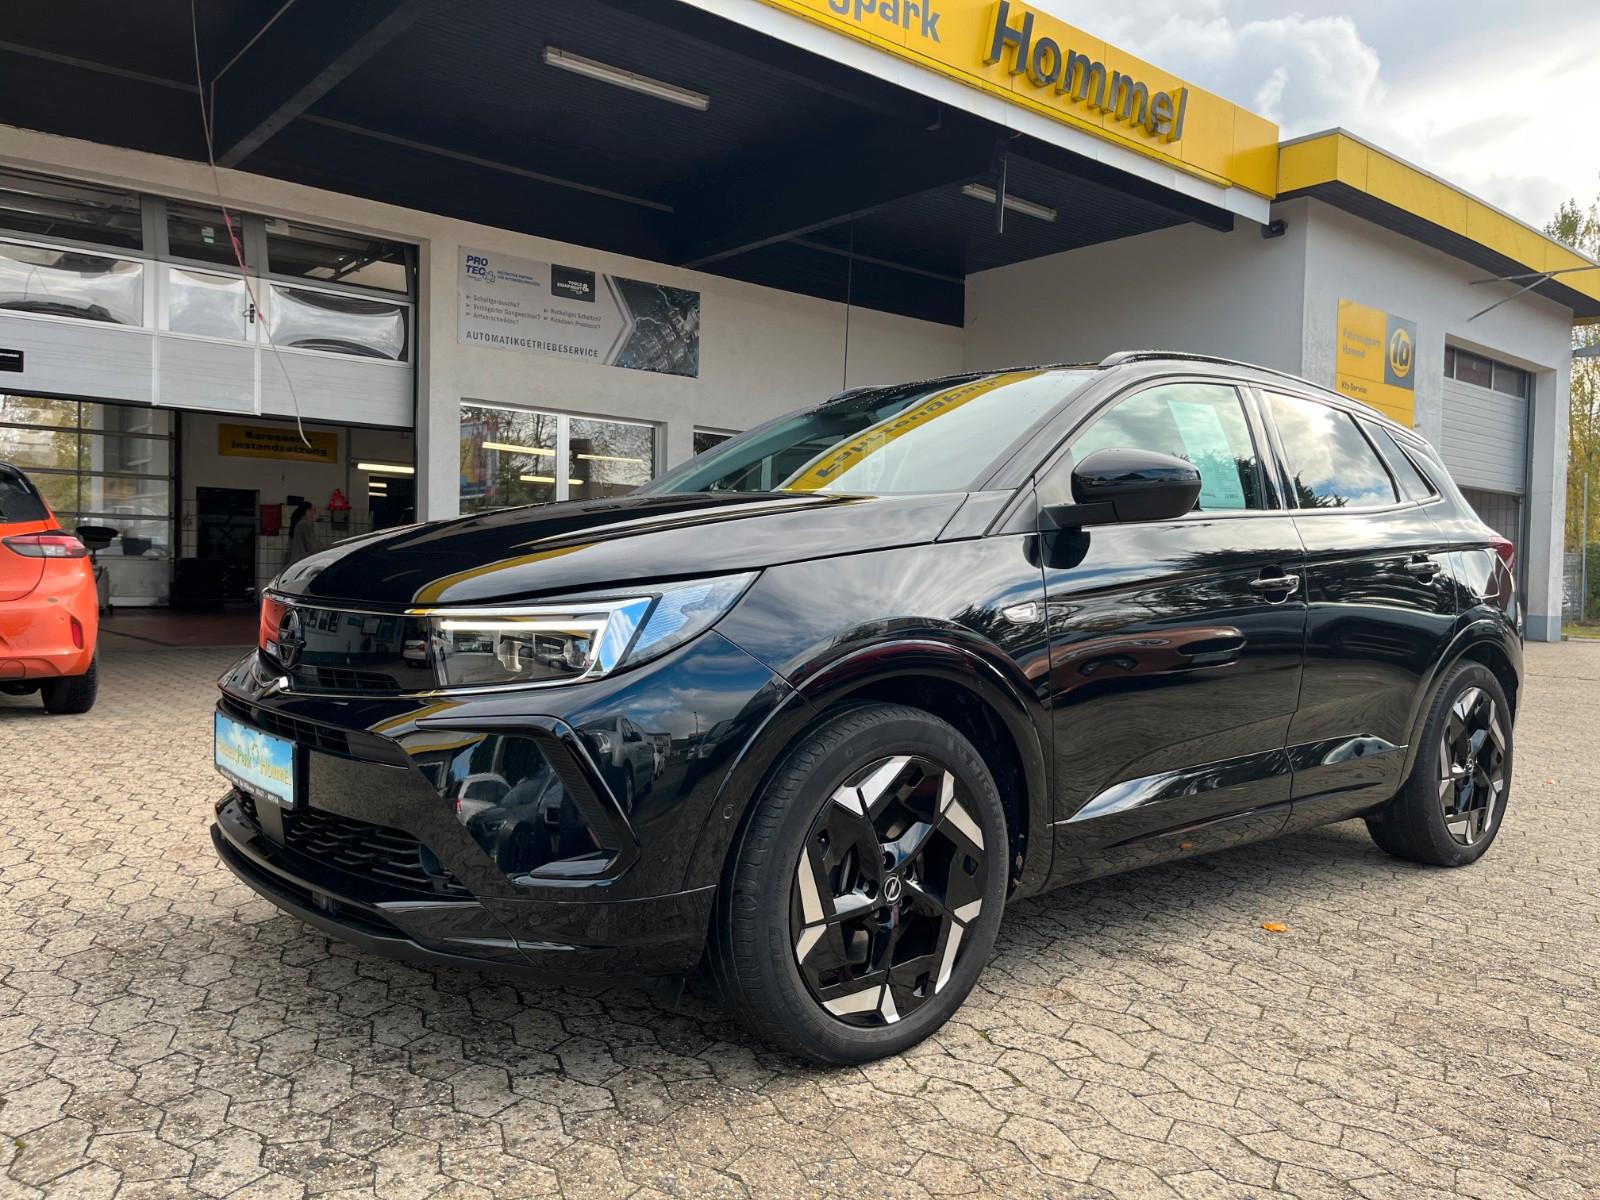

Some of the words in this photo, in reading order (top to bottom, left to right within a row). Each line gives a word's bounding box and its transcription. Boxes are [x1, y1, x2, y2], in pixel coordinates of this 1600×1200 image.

[986, 0, 1188, 142] Hommel
[465, 264, 486, 276] TEC
[466, 254, 488, 266] PRO
[466, 330, 599, 358] AUTOMATIKGETRIEBESERVICE
